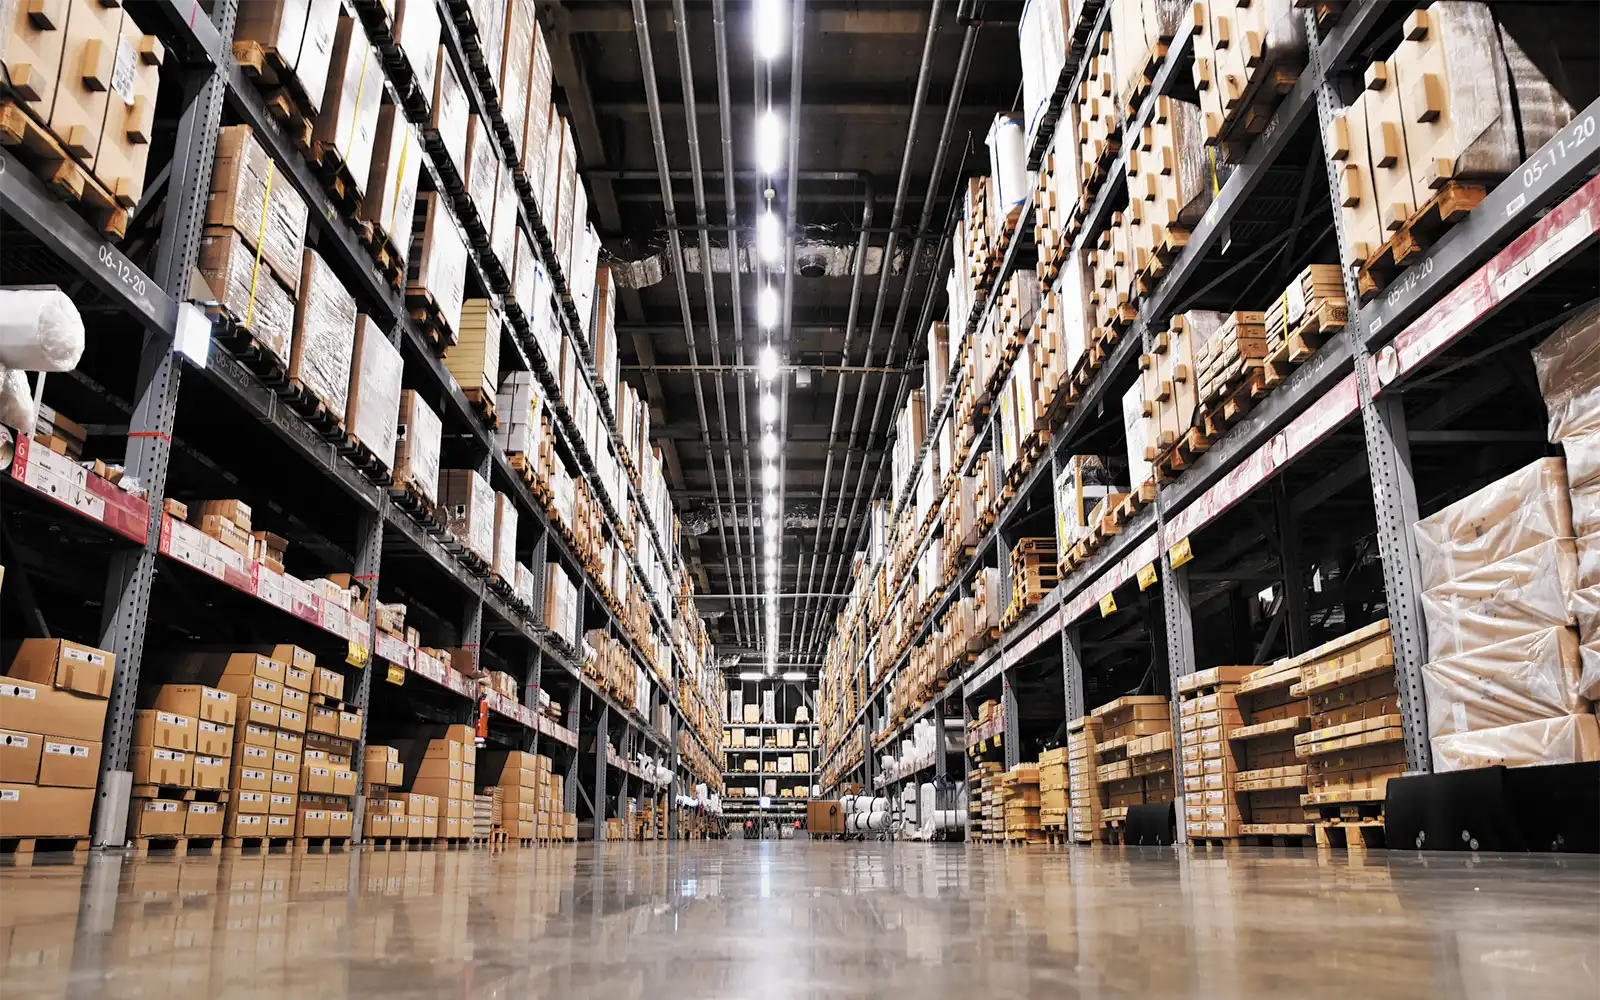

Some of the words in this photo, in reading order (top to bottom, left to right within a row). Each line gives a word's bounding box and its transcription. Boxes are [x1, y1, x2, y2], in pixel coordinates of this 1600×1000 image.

[1523, 116, 1596, 188] 05-11-20
[98, 245, 146, 296] 06-12-20
[1387, 256, 1434, 307] 05-12-20
[215, 350, 250, 388] 06-13-20
[1291, 354, 1325, 392] 05-13-20
[18, 442, 25, 456] 6
[14, 463, 25, 481] 12
[164, 521, 170, 533] 6
